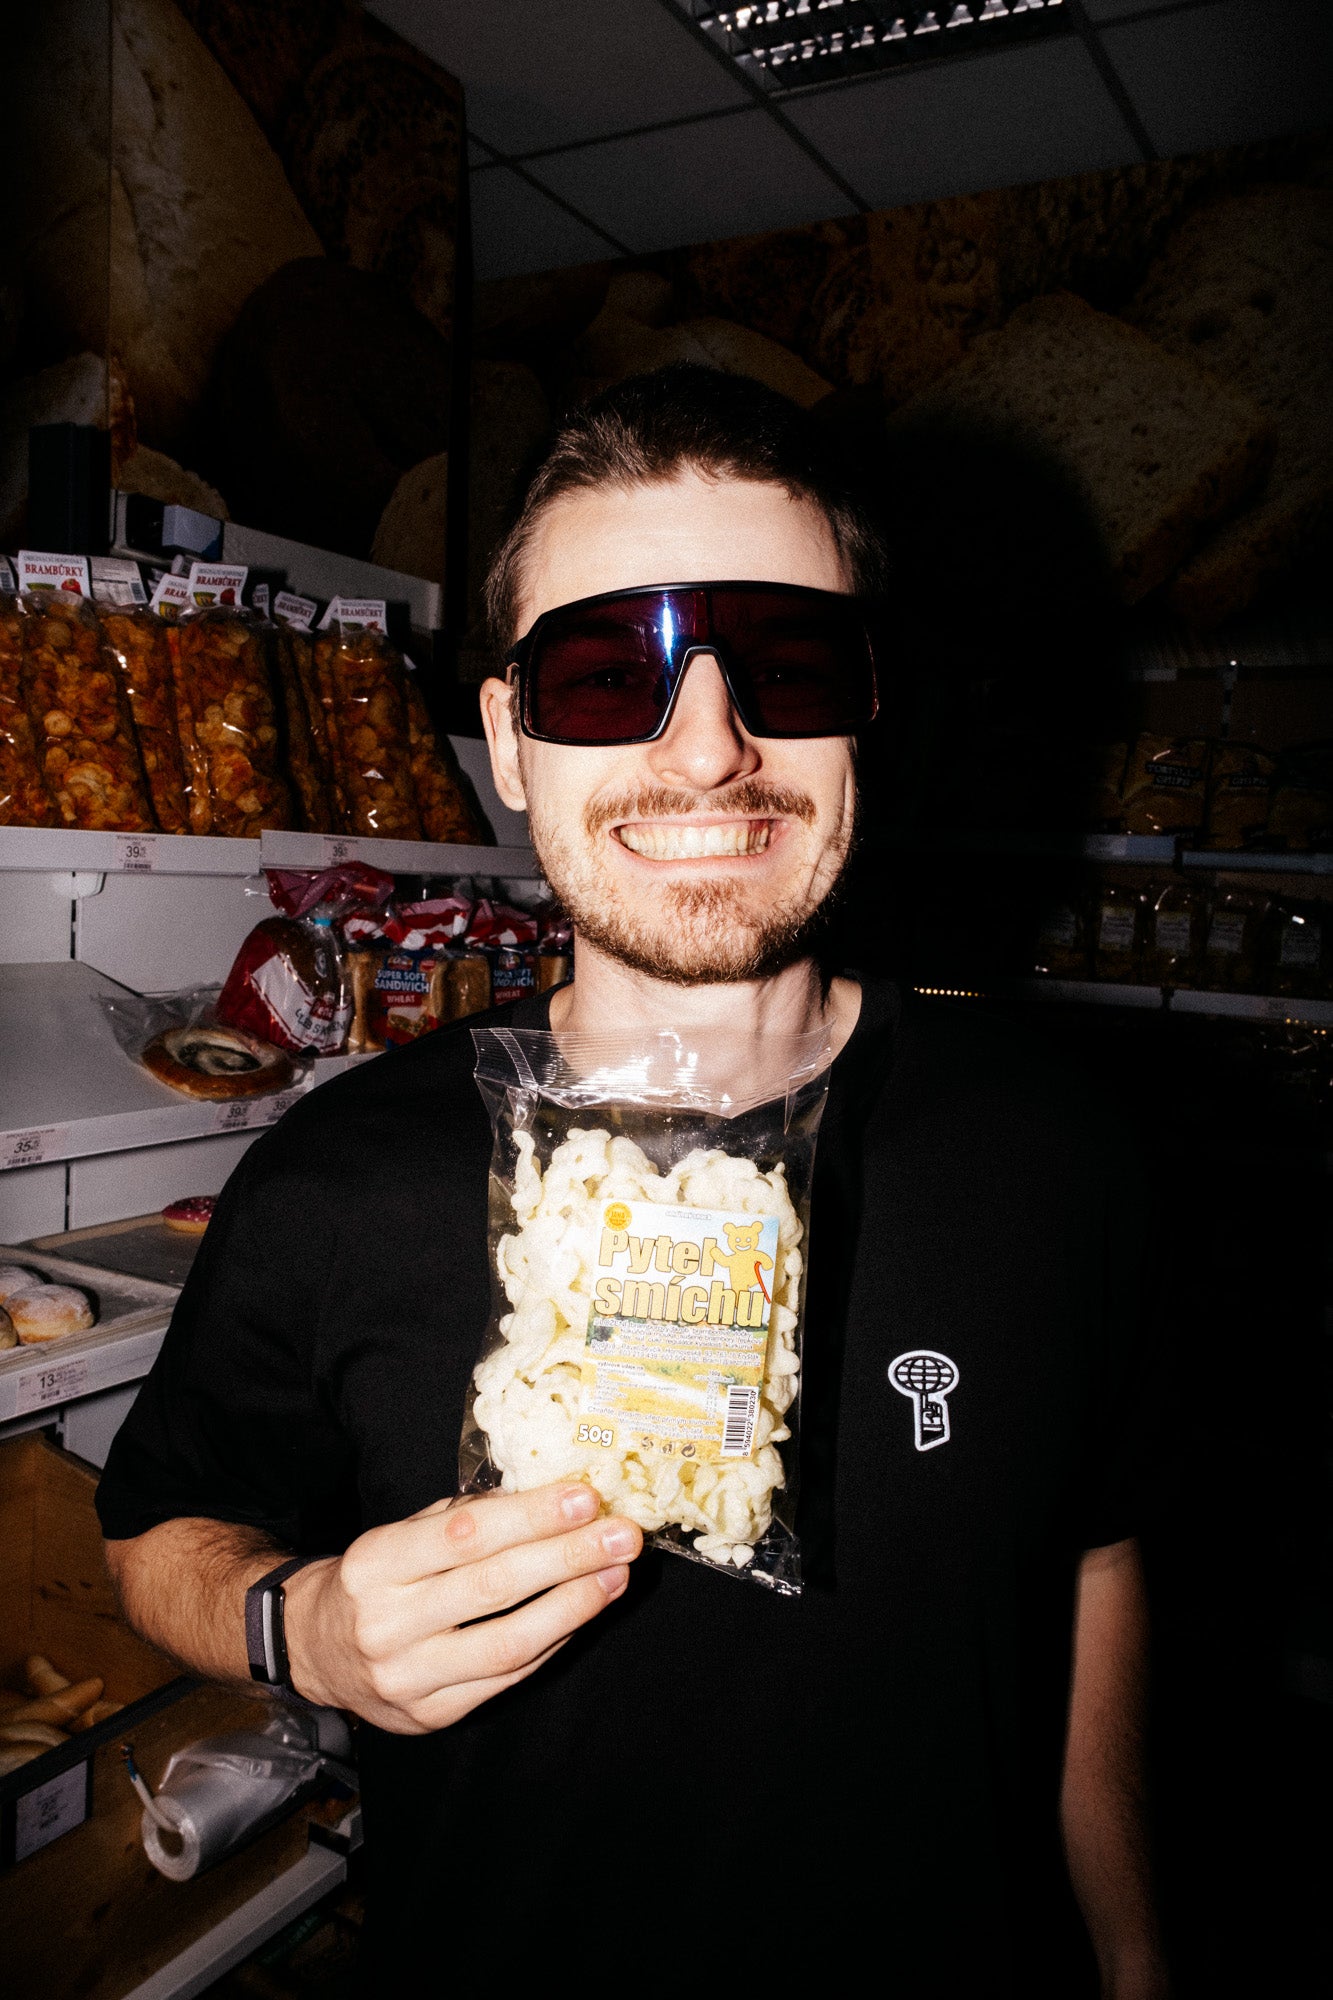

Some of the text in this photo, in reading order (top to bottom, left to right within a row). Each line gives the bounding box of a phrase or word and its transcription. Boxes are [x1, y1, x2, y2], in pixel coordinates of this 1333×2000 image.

[164, 587, 188, 598] BRAM
[377, 969, 426, 982] SUPER SOFT
[374, 978, 430, 993] SANDWICH
[387, 995, 415, 1003] WHEAT
[598, 1227, 717, 1277] Pytel
[594, 1276, 765, 1327] smíchu
[577, 1423, 615, 1448] 50g
